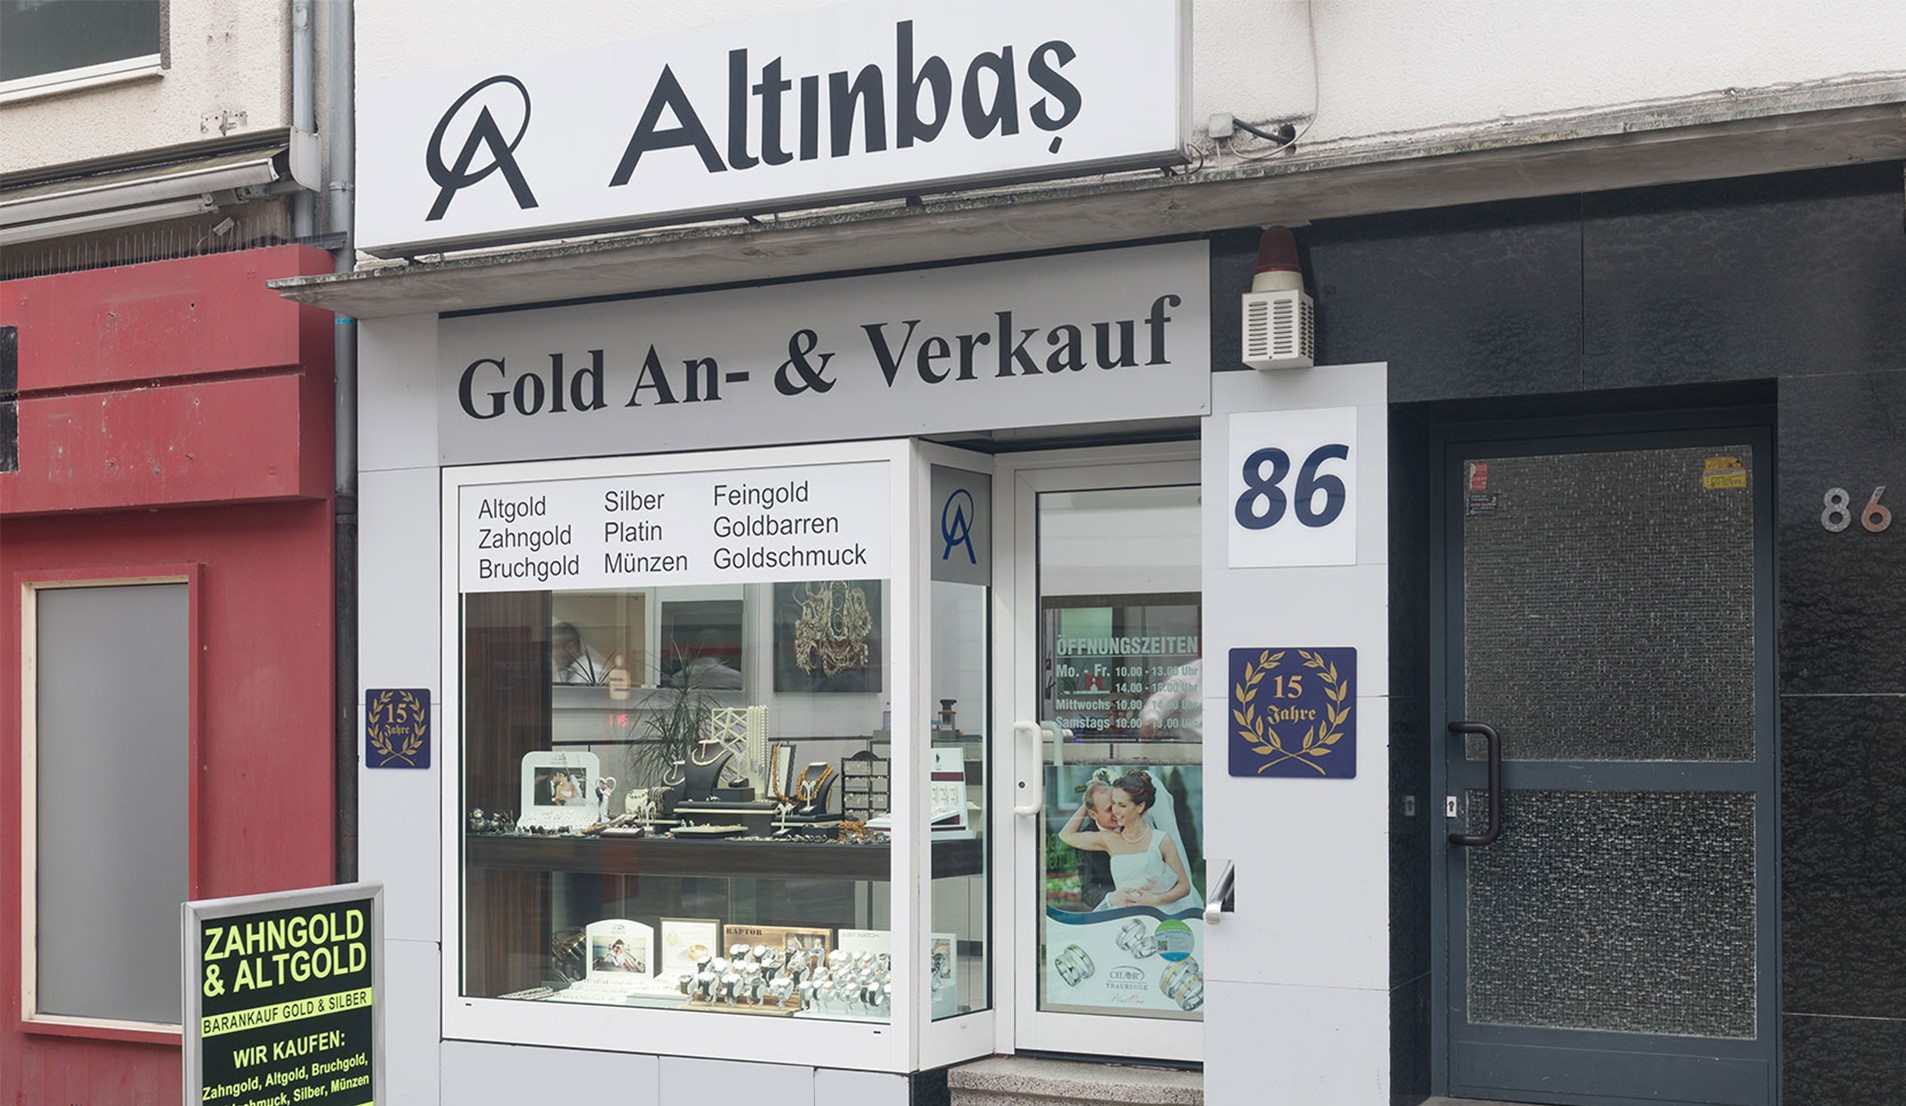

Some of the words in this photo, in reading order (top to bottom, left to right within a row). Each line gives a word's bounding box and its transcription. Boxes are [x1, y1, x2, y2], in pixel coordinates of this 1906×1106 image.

[609, 20, 1083, 187] Altınbaş
[458, 349, 606, 421] Gold
[625, 344, 750, 407] An-
[774, 328, 837, 395] &
[860, 294, 1182, 387] Verkauf
[714, 481, 809, 509] Feingold
[1235, 444, 1350, 530] 86
[478, 496, 547, 522] Altgold
[604, 490, 665, 512] Silber
[1820, 486, 1892, 533] 86
[478, 525, 572, 552] Zahngold
[604, 519, 663, 543] Platin
[714, 514, 839, 539] Goldbarren
[478, 555, 579, 582] Bruchgold
[604, 551, 688, 574] Münzen
[714, 544, 867, 570] Goldschmuck
[1057, 635, 1198, 656] ÖFFNUNGSZEITEN
[1056, 665, 1080, 678] Mo.
[1094, 664, 1110, 677] Fr.
[1115, 666, 1142, 677] 10.00
[1182, 666, 1198, 676] Uhr
[1115, 683, 1142, 693] 14.00
[1272, 674, 1304, 699] 15
[387, 703, 408, 723] 15
[1056, 699, 1110, 710] Mittwochs
[1266, 705, 1316, 726] Jahre
[384, 725, 410, 737] Jahre
[1056, 716, 1110, 731] Samstags
[204, 909, 364, 961] ZAHNGOLD
[726, 928, 762, 936] RAPTOR
[203, 963, 225, 997] &
[233, 942, 367, 993] ALTGOLD
[203, 1007, 278, 1034] BARANKAUF
[282, 1000, 314, 1019] GOLD
[317, 999, 325, 1012] &
[329, 991, 367, 1010] SILBER
[233, 1045, 268, 1069] WIR
[273, 1030, 346, 1061] KAUFEN:
[202, 1075, 262, 1102] Zahngold,
[265, 1067, 308, 1088] Altgold,
[311, 1052, 368, 1078] Bruchgold,
[293, 1084, 328, 1102] Silber,
[331, 1073, 370, 1094] Münzen
